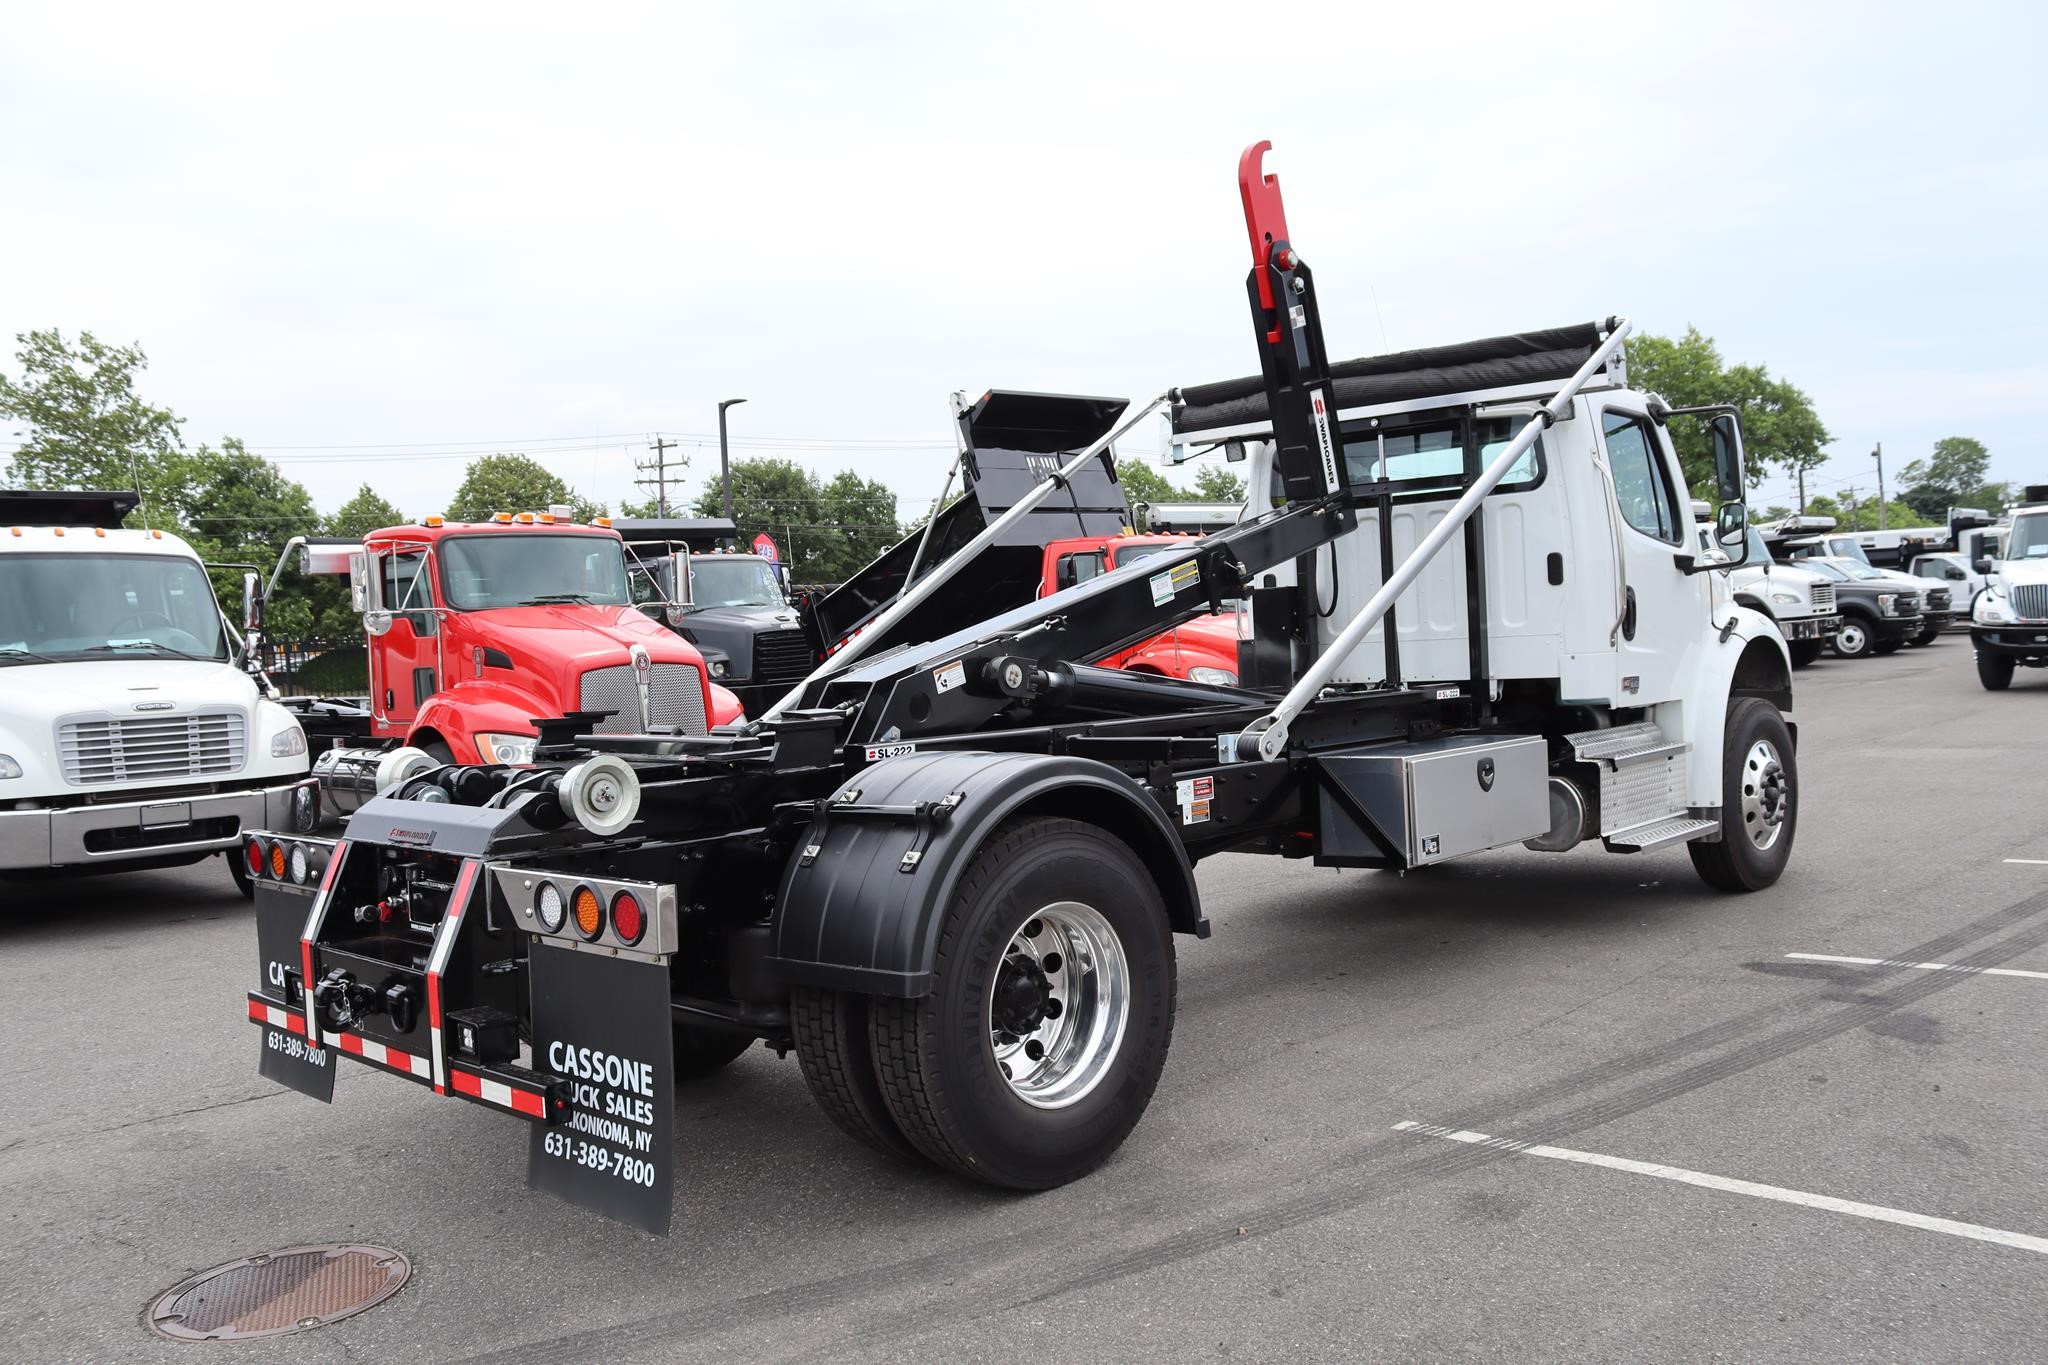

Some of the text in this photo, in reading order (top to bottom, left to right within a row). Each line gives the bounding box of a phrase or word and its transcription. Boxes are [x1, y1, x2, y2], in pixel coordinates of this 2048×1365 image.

[1318, 417, 1335, 484] SWAPLOADER
[268, 1031, 326, 1067] 631-389-7800
[549, 1041, 654, 1097] CASSONE
[571, 1081, 654, 1126] UCK SALES
[564, 1110, 653, 1153] KONKOMA, NY
[544, 1131, 655, 1188] 631-389-7800
